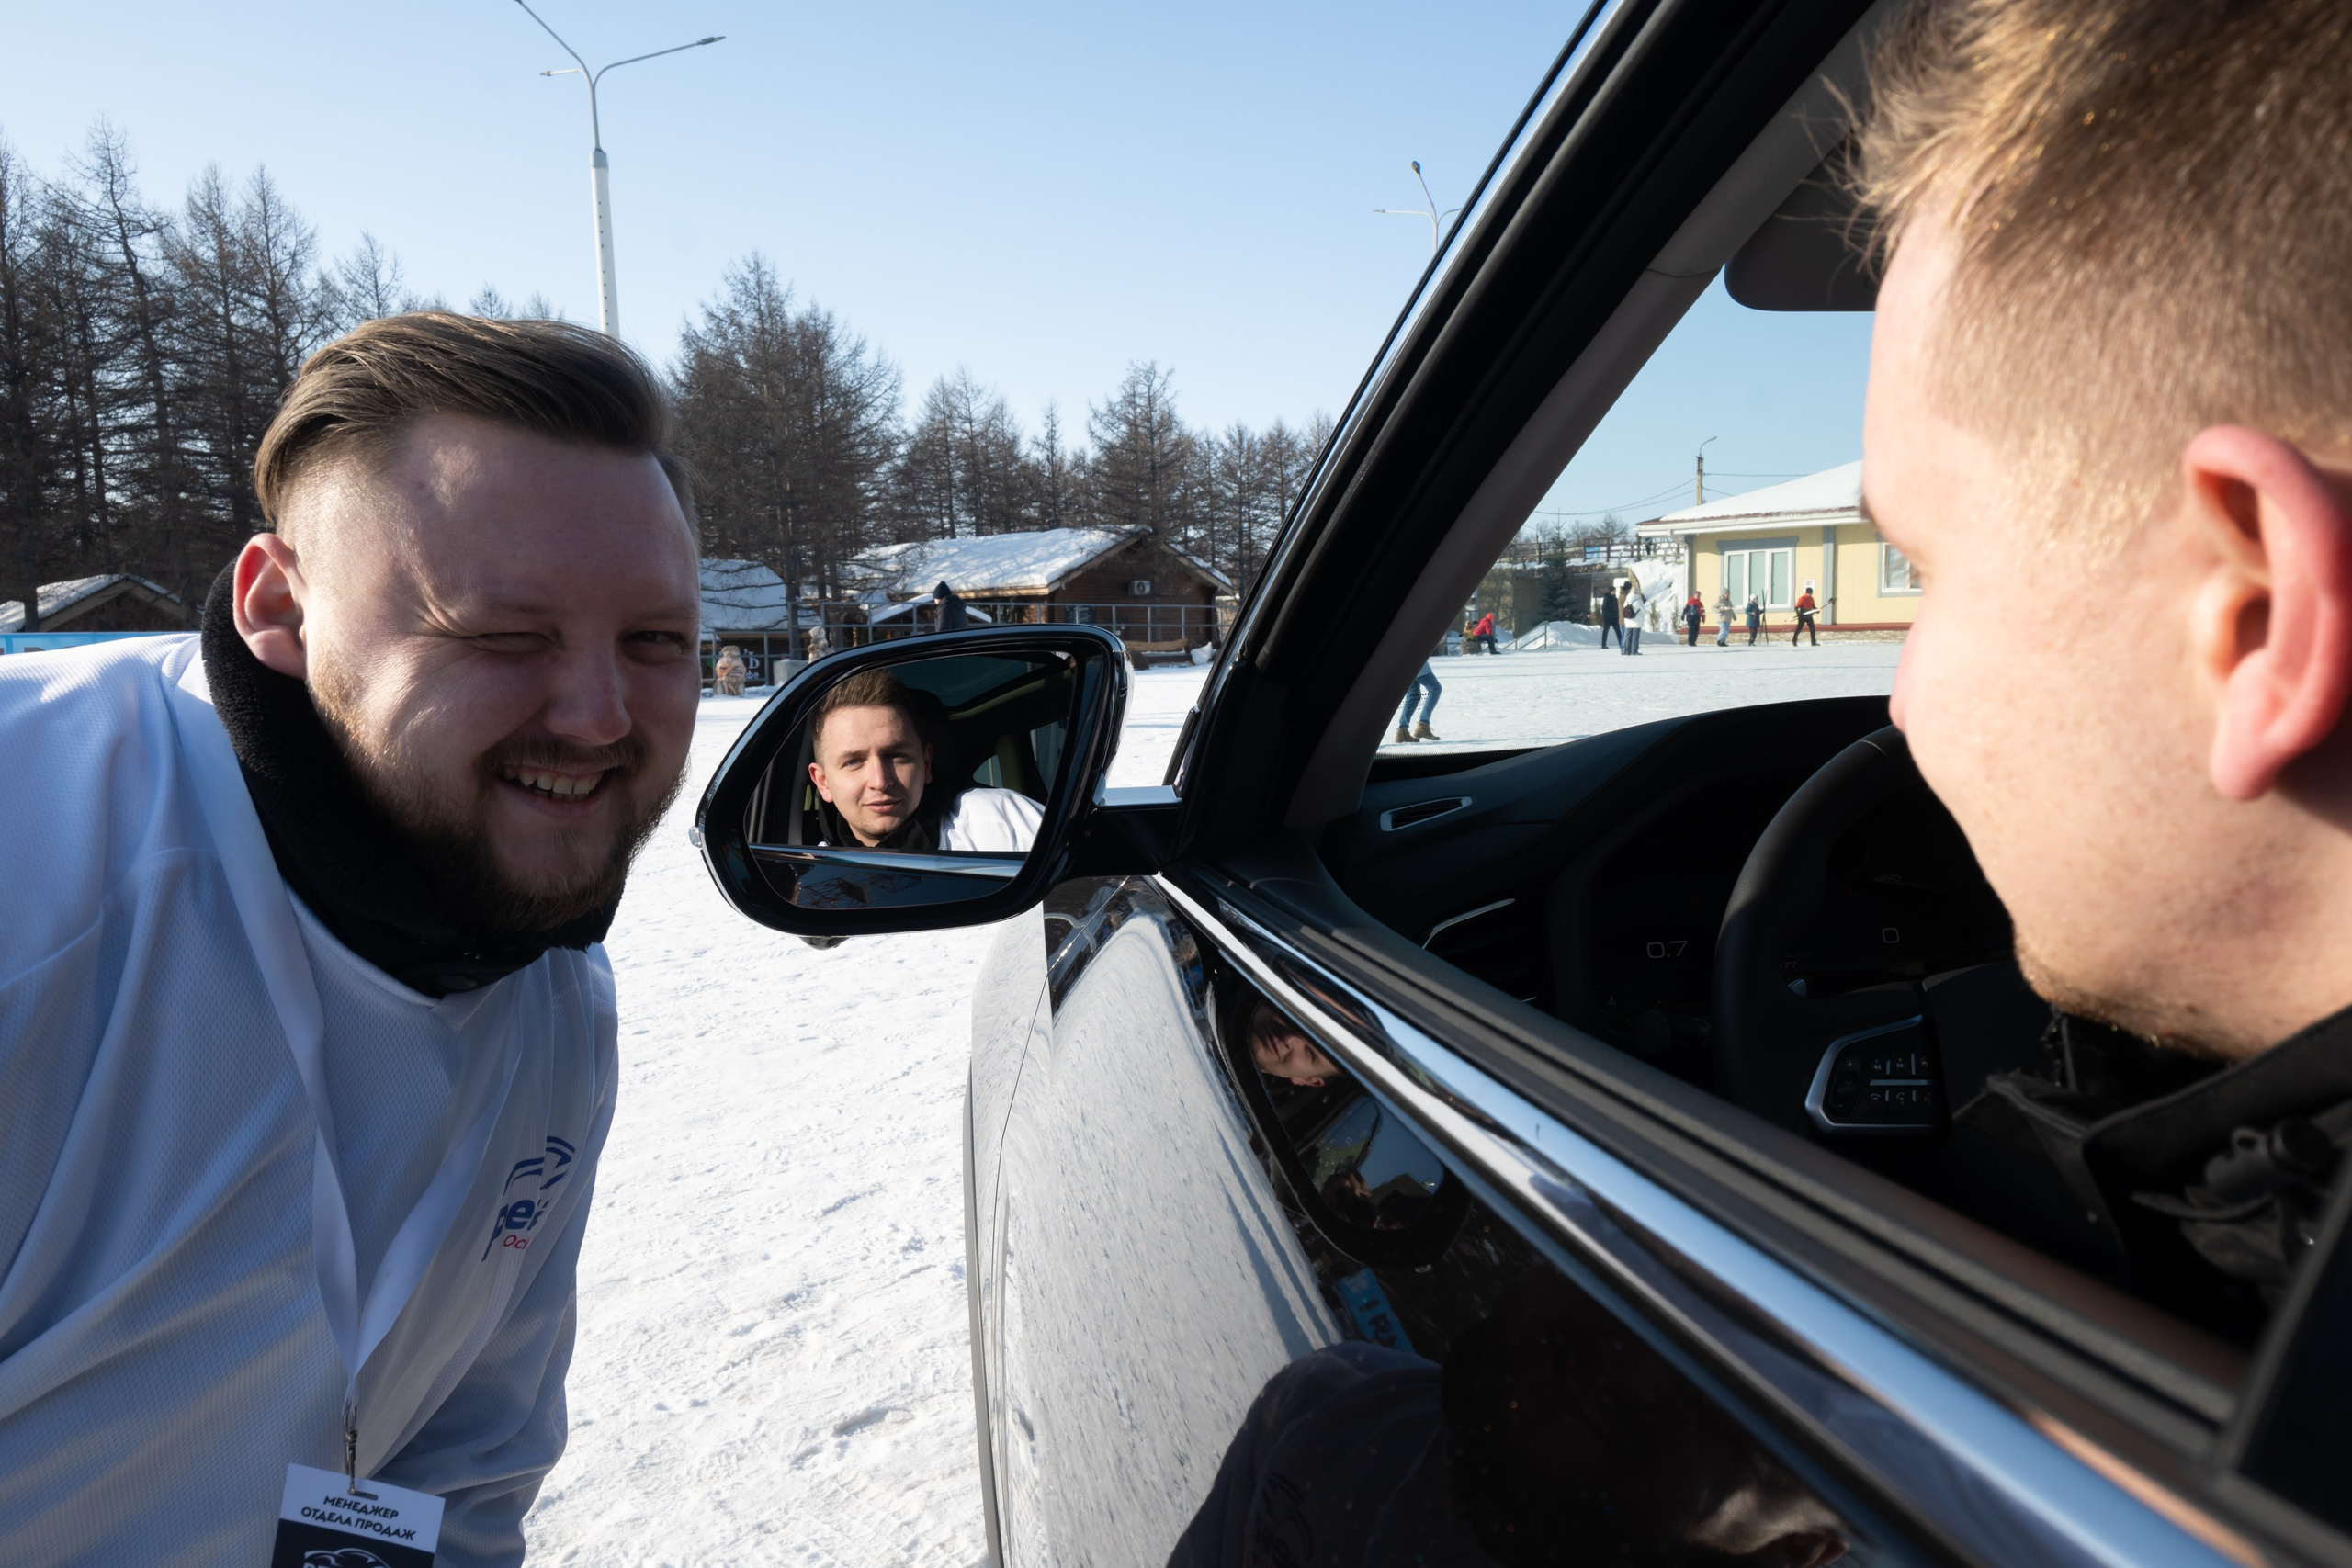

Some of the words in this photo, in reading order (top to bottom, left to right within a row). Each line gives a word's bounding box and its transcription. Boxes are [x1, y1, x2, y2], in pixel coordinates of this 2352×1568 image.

[1882, 927, 1900, 944] 0
[1646, 940, 1688, 958] 0.7
[323, 1495, 399, 1519] МЕНЕДЖЕР
[300, 1506, 352, 1527] ОТДЕЛА
[355, 1518, 416, 1541] ПРОДАЖ
